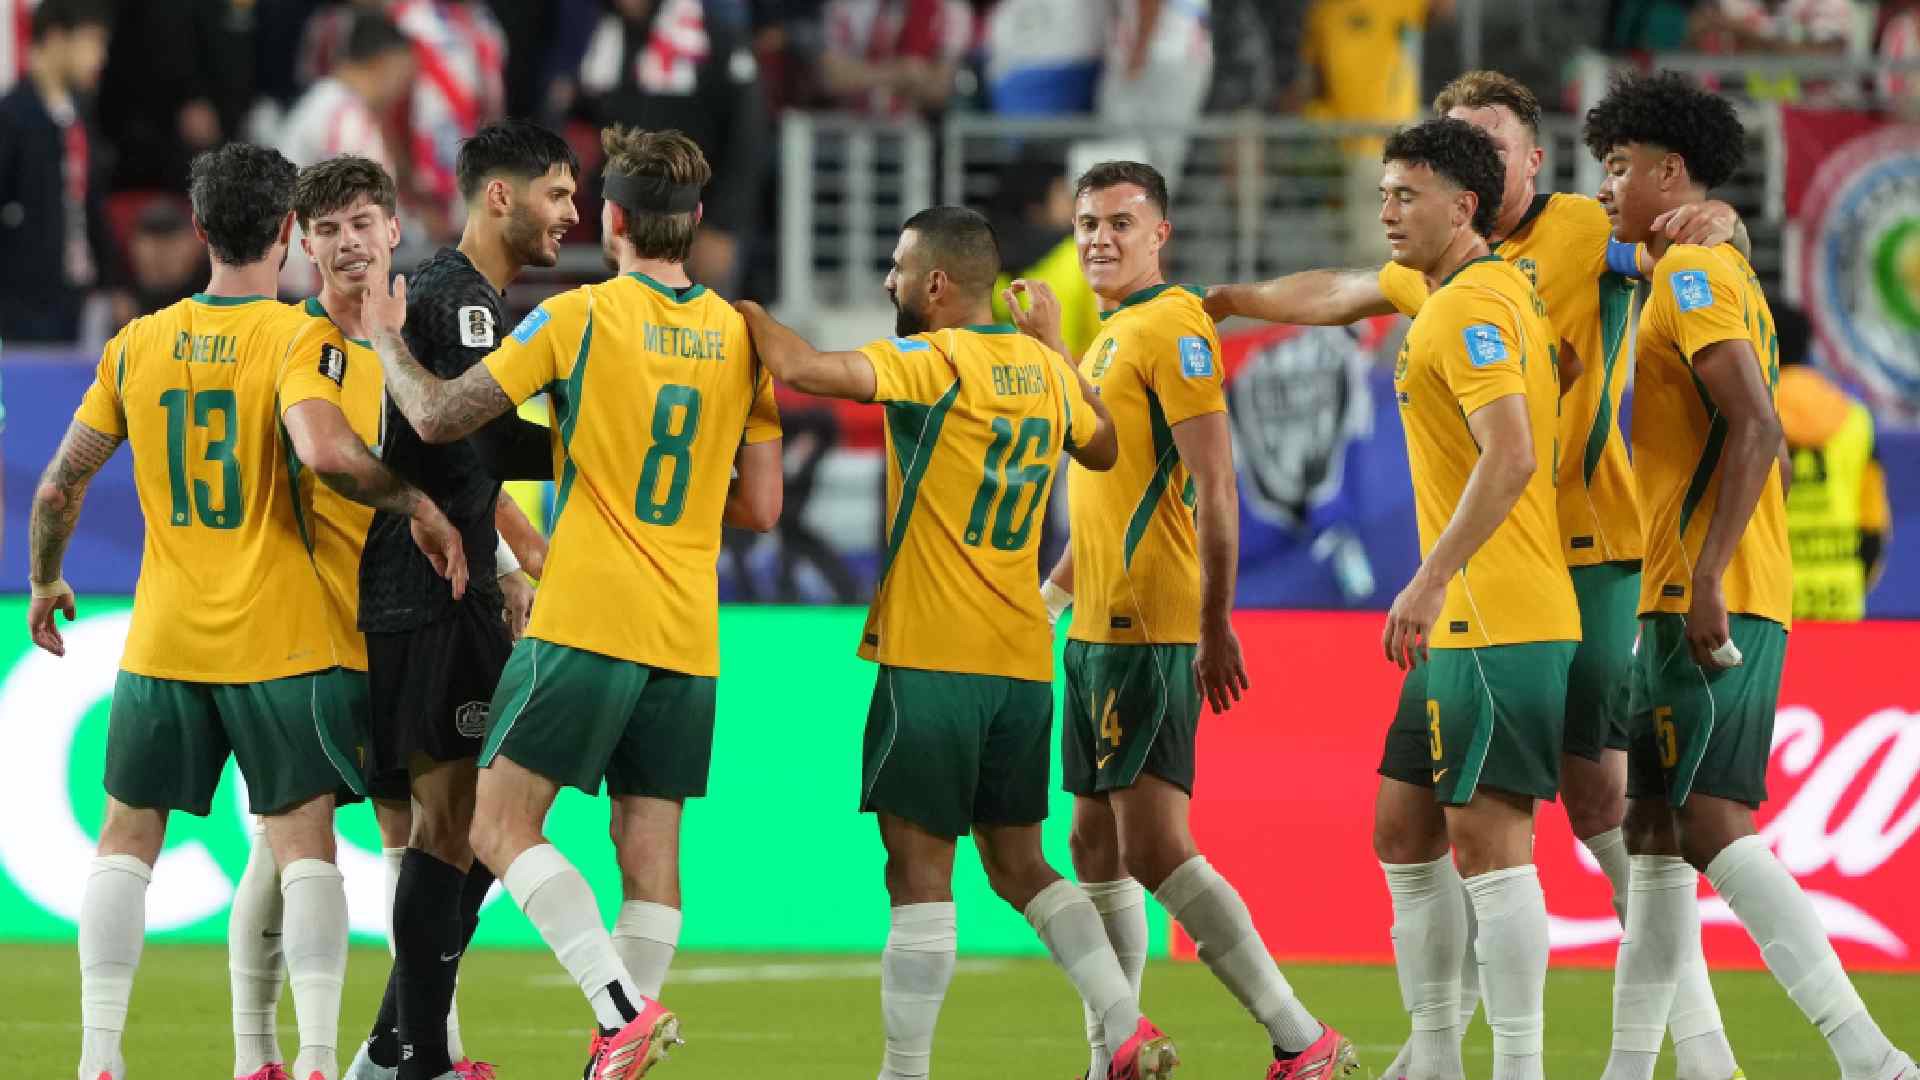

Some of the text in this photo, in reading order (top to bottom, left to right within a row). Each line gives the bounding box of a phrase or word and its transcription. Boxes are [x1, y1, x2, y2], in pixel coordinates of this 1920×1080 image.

[160, 388, 245, 530] 13
[635, 383, 703, 527] 8
[963, 416, 1052, 551] 16
